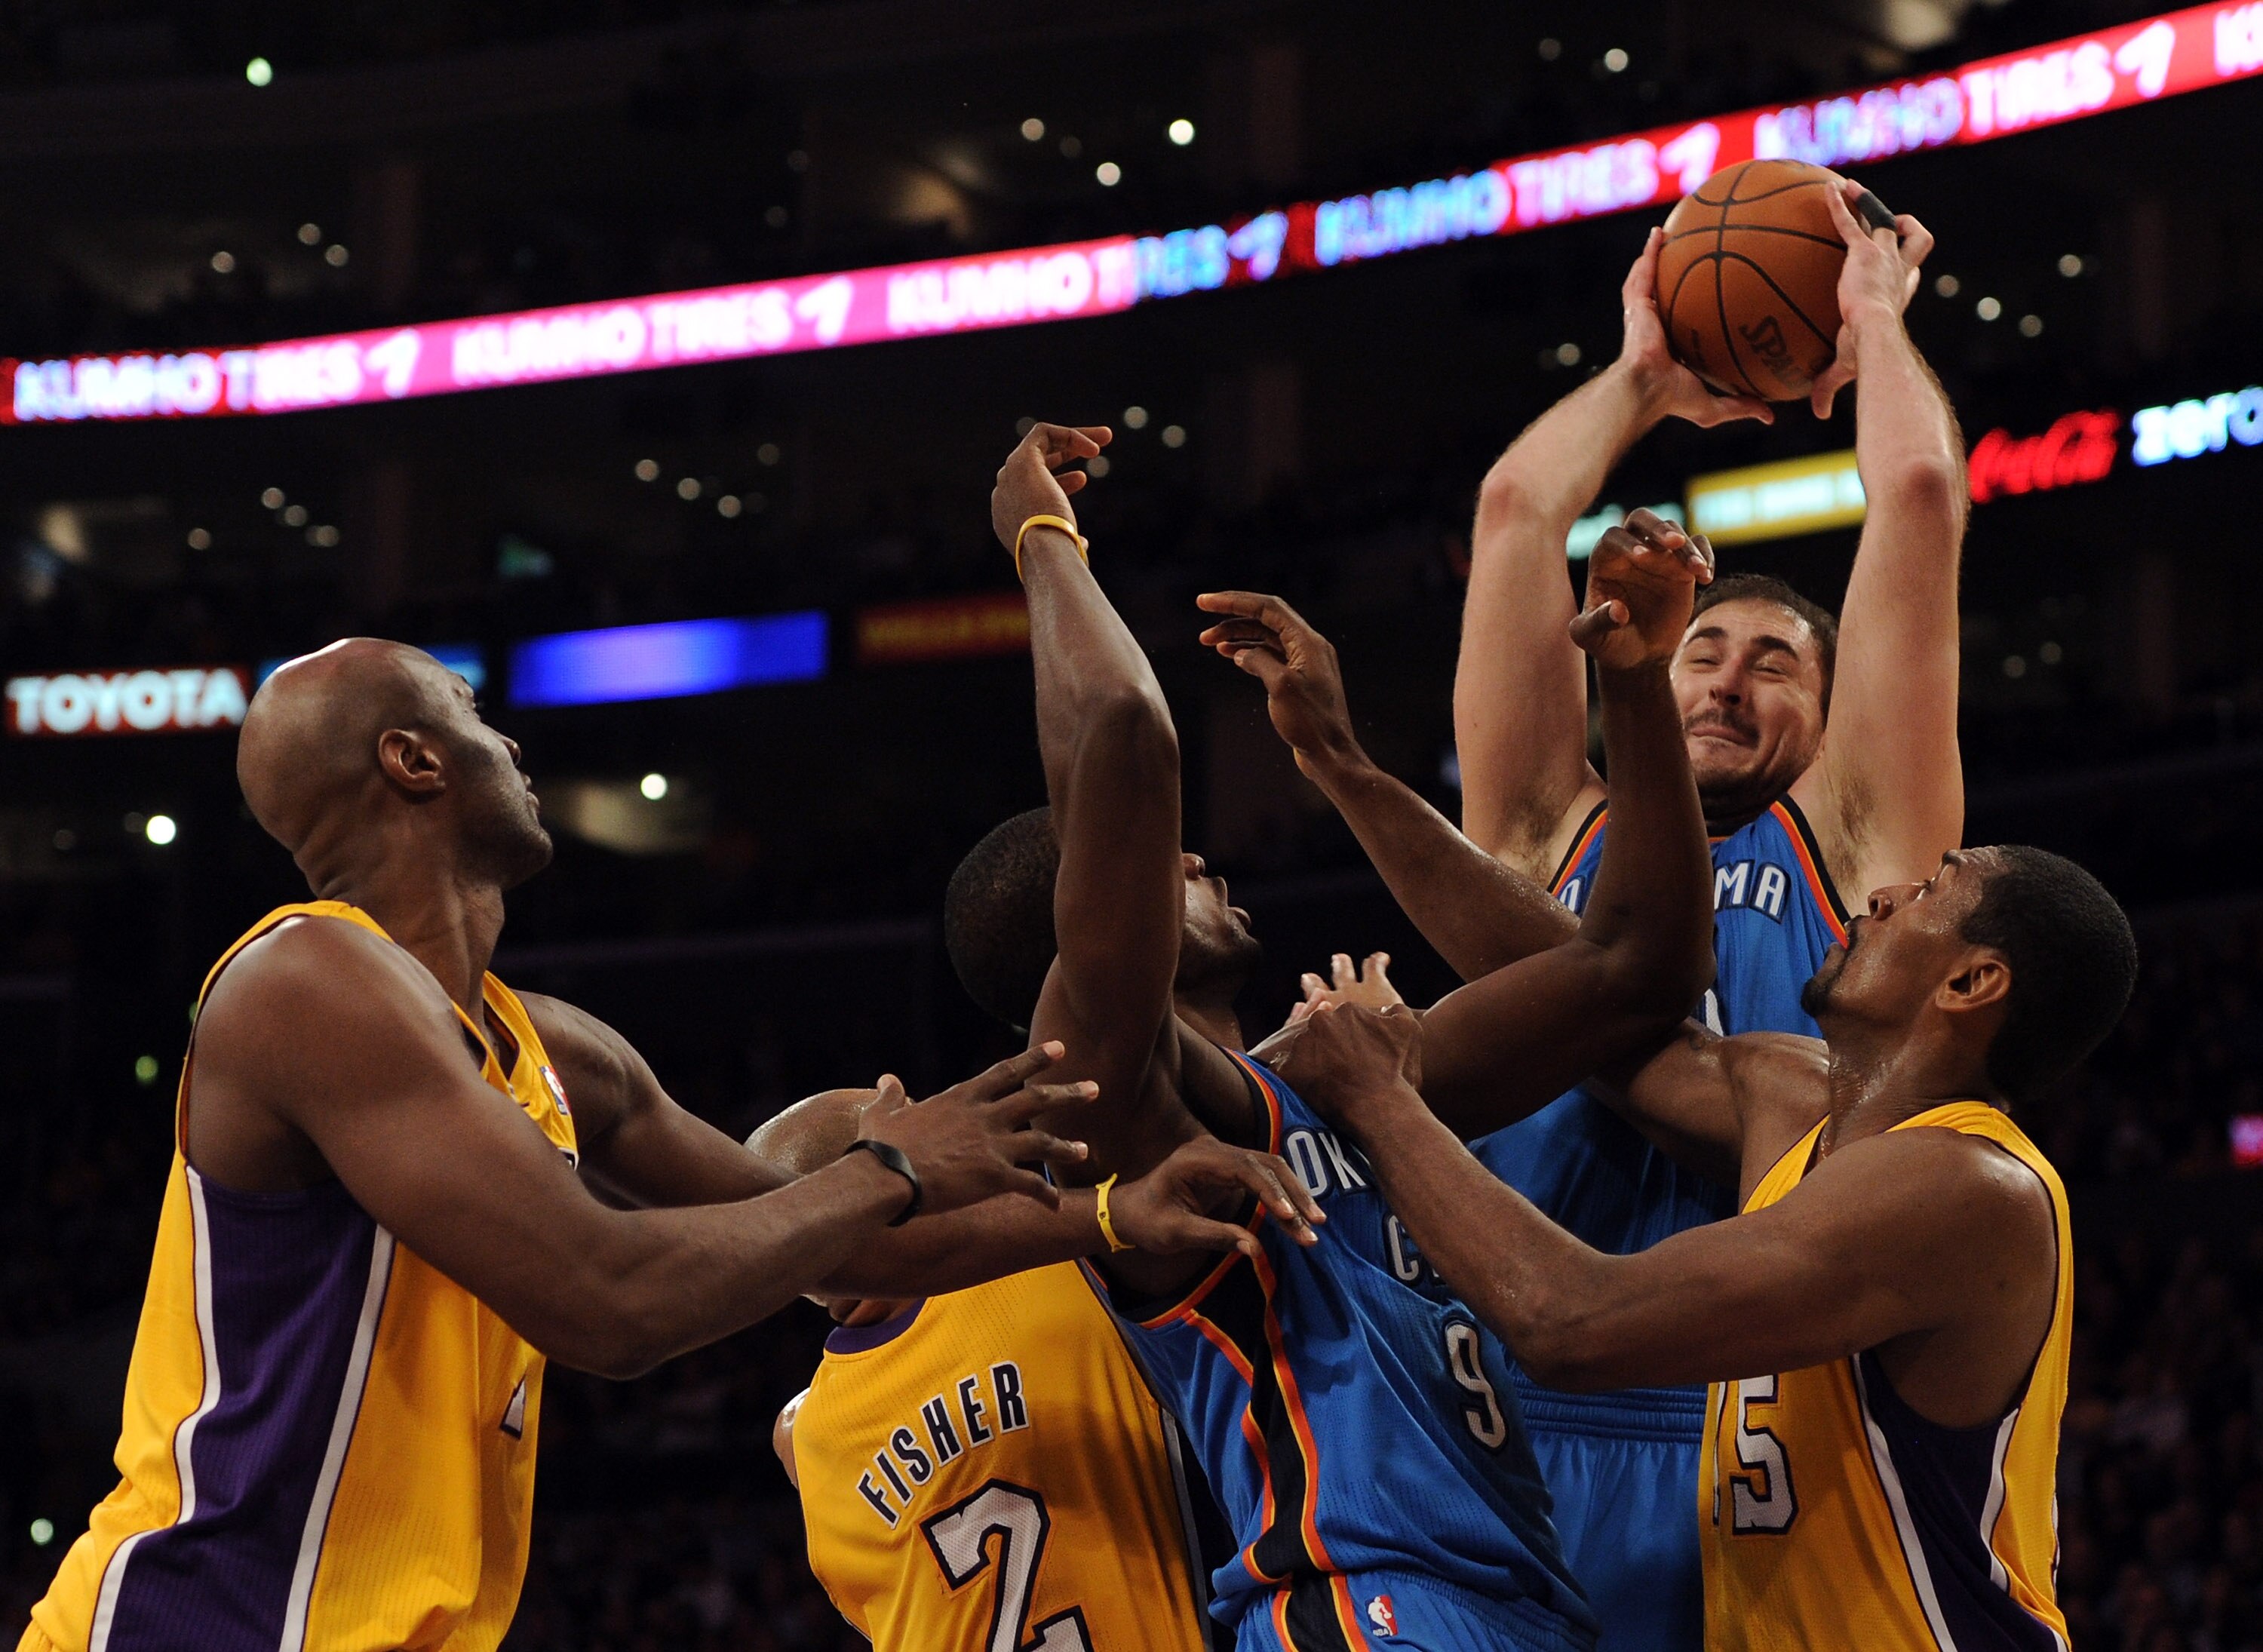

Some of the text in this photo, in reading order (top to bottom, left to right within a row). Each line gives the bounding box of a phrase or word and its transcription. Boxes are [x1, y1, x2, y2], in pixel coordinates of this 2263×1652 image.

[1963, 41, 2114, 137] TIRES
[1316, 139, 1658, 266] KUMHO TIRES
[886, 226, 1230, 334] KUMHO TIRES
[14, 341, 364, 421] KUMHO TIRES
[453, 287, 794, 386] KUMHO TIRES
[2133, 386, 2263, 467] zero
[5, 668, 247, 734] TOYOTA
[1442, 1319, 1509, 1453] 9
[855, 1359, 1030, 1530] FISHER
[919, 1477, 1095, 1652] 2
